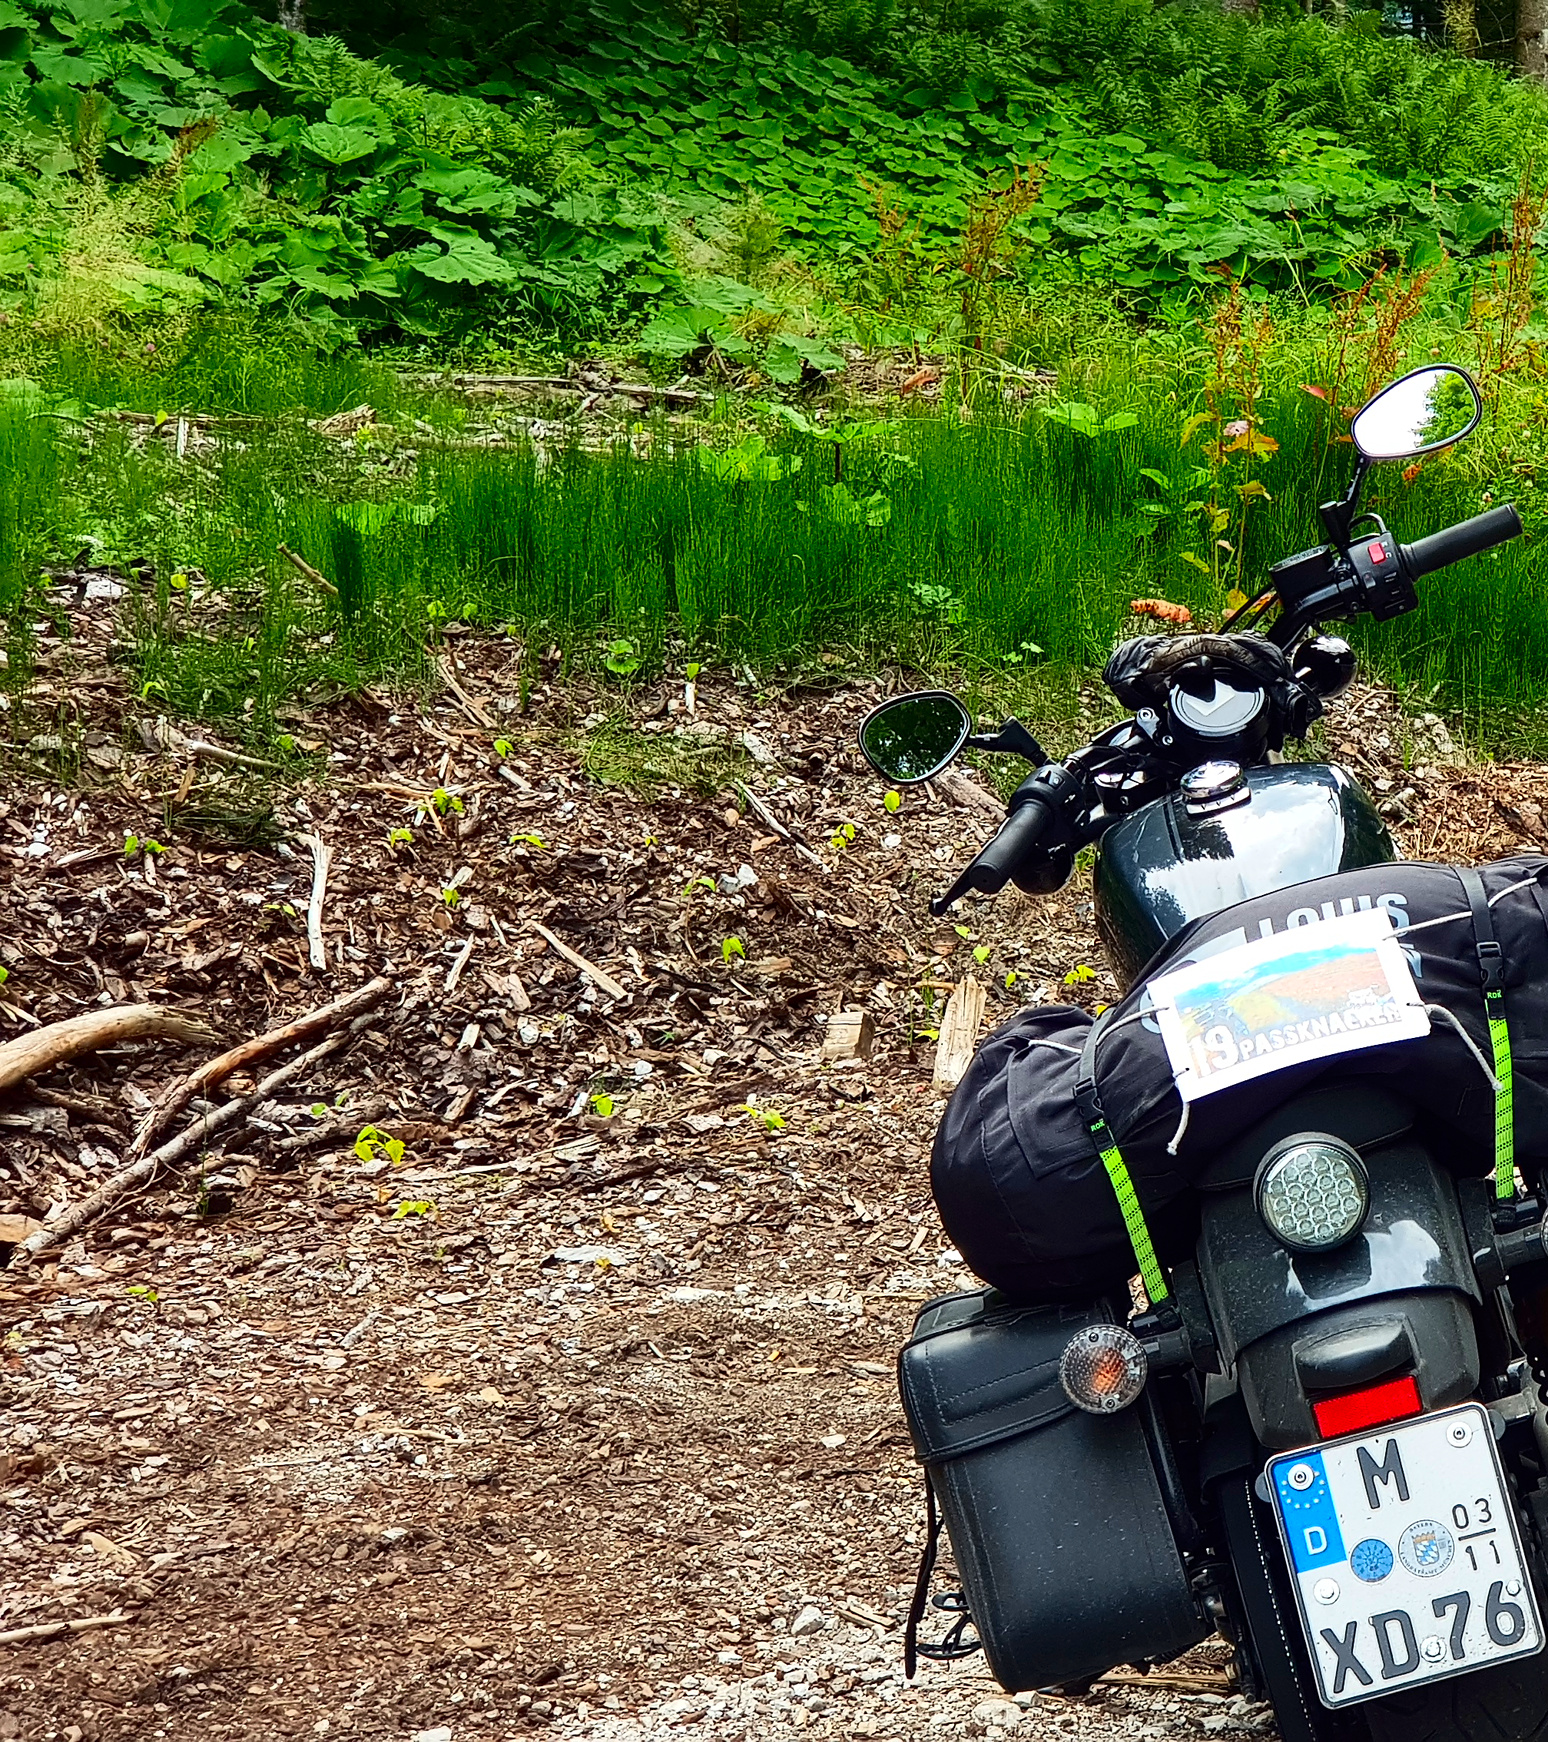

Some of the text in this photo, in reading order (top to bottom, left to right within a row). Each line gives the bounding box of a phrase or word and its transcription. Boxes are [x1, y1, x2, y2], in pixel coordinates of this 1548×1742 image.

[1356, 1438, 1411, 1509] M
[1451, 1498, 1492, 1530] 03
[1303, 1526, 1327, 1555] D
[1465, 1540, 1501, 1571] 11
[1320, 1581, 1526, 1694] XD 76
